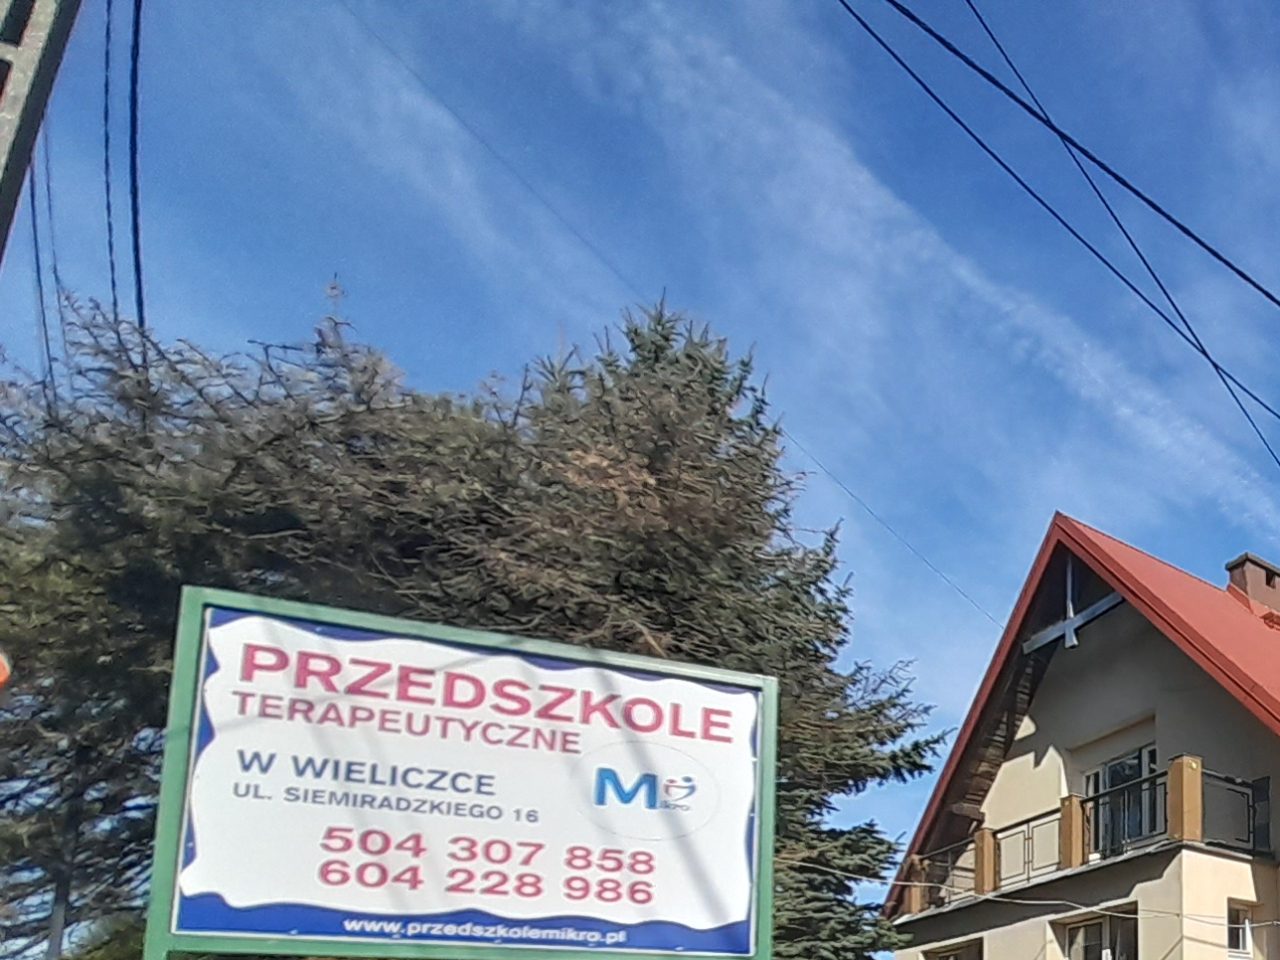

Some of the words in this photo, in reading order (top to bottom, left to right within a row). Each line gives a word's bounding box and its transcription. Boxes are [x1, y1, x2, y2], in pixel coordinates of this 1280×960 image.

[239, 643, 733, 743] PRZEDSZKOLE
[233, 691, 582, 754] TERAPEUTYCZNE
[237, 749, 276, 775] W
[292, 755, 496, 796] WIELICZCE
[233, 782, 273, 800] UL.
[283, 786, 504, 820] SIEMIRADZKIEGO
[513, 808, 540, 823] 16
[319, 827, 428, 858] 504
[448, 836, 546, 867] 307
[565, 848, 656, 875] 858
[318, 861, 425, 891] 604
[445, 869, 544, 898] 228
[563, 877, 654, 905] 986
[343, 918, 628, 944] www.przedszkolemikro.pl
